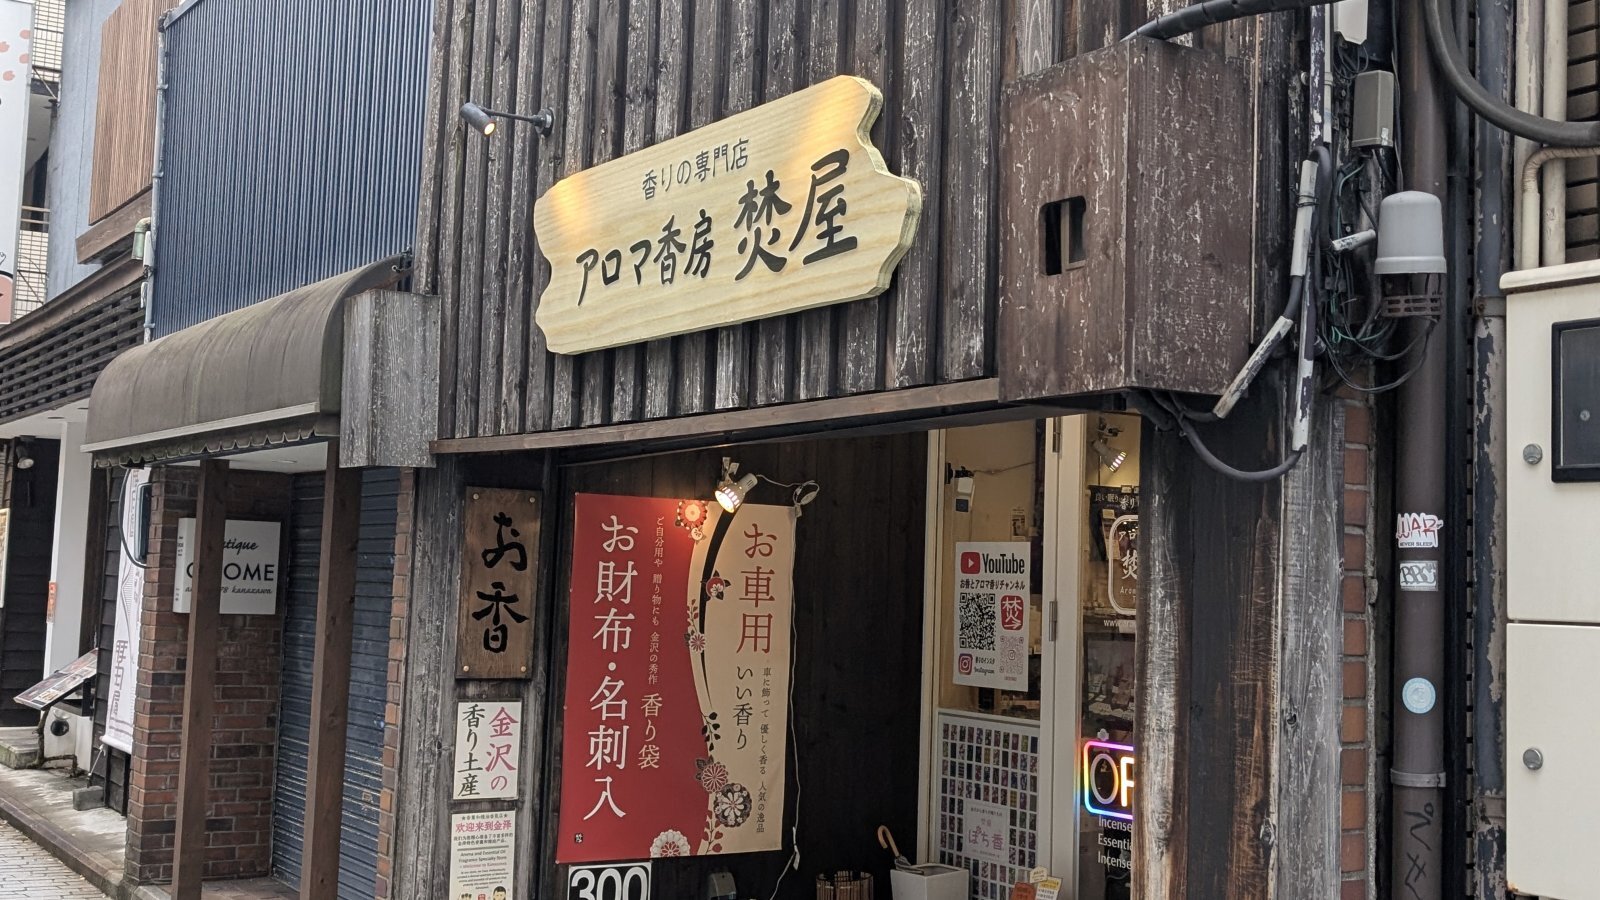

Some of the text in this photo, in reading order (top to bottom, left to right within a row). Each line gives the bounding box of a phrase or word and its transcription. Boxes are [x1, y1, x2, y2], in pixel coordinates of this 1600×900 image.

[642, 138, 749, 200] 香りの専門店
[575, 148, 858, 306] アロマ香房 焚屋
[472, 511, 530, 653] お香
[648, 516, 664, 685] ご自分用や 贈り物にも 金沢の秀作
[982, 553, 1025, 574] YouTube
[583, 515, 638, 821] お財布・名刺入
[732, 523, 777, 750] お車用 いい香り
[457, 703, 485, 797] 香り土産
[485, 706, 519, 791] 金沢の
[638, 693, 663, 769] 香り袋
[756, 667, 771, 833] 車に飾って 優しく香る 人気の逸品
[456, 820, 512, 833] 欢迎来到金泽
[968, 826, 1004, 851] ぽち香
[571, 867, 648, 900] 300
